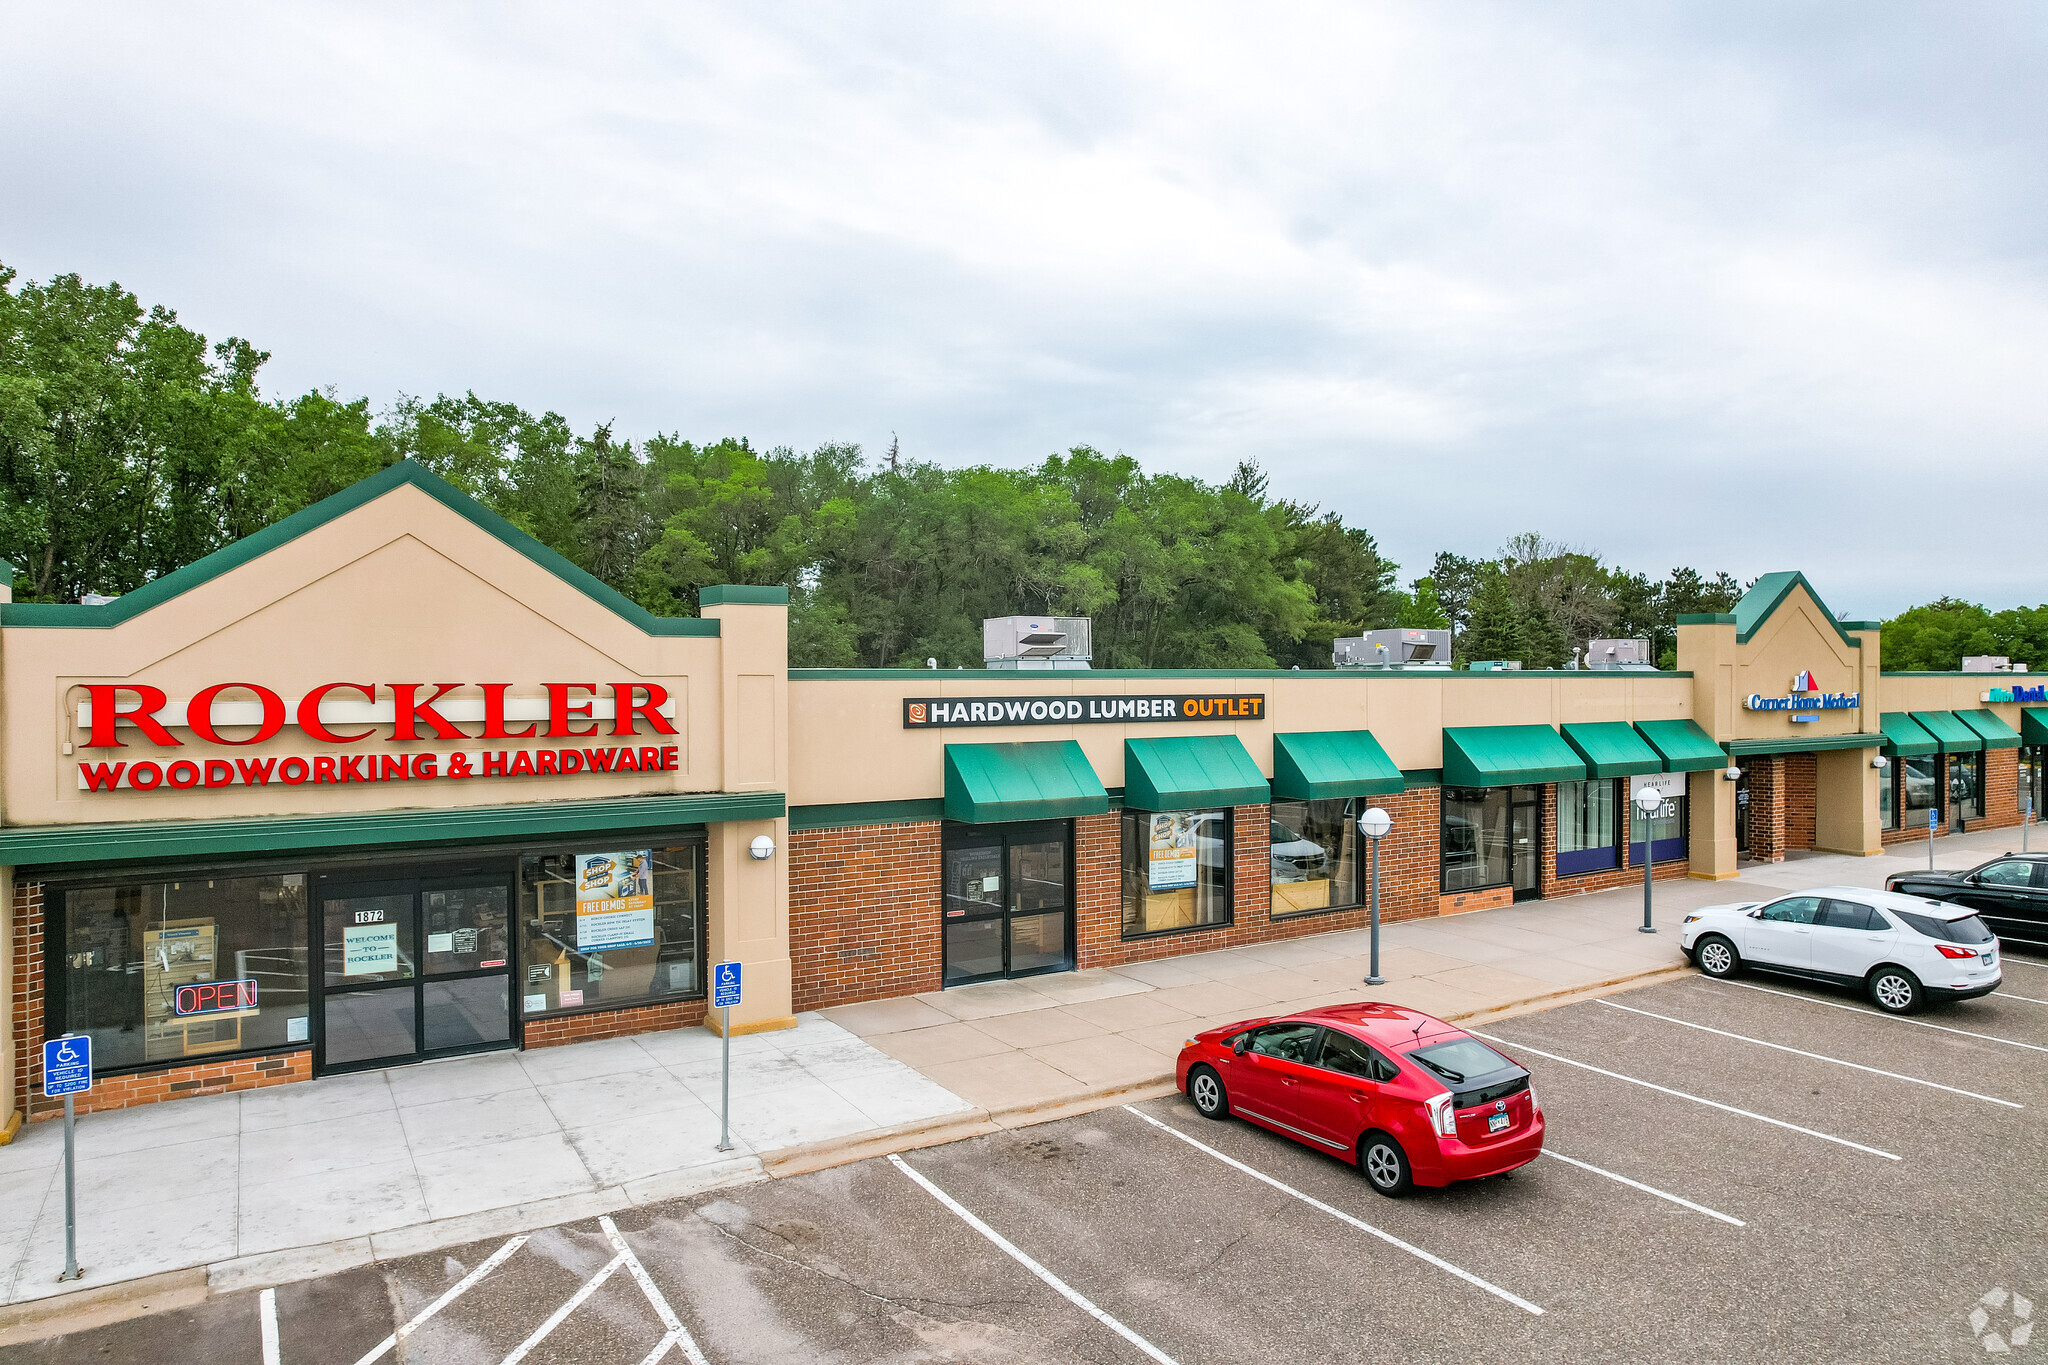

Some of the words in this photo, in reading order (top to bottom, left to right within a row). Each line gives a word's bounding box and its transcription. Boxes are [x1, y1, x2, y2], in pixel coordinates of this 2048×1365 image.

[1750, 694, 1790, 711] Corner
[1791, 693, 1821, 710] Home
[1822, 692, 1860, 709] Medical
[79, 682, 680, 748] ROCKLER
[931, 699, 1083, 723] HARDWOOD
[1089, 698, 1177, 719] LUMBER
[1183, 697, 1263, 717] OUTLET
[79, 753, 438, 792] WOODWORKING
[447, 751, 473, 779] &
[483, 746, 679, 777] HARDWARE
[586, 863, 612, 877] SHOP
[584, 876, 610, 889] SHOP
[582, 901, 600, 913] FREE
[600, 899, 626, 912] DEMOS
[356, 911, 383, 923] 1872
[346, 934, 395, 944] WELCOME
[347, 953, 393, 963] ROCKLER
[178, 981, 255, 1013] OPEN
